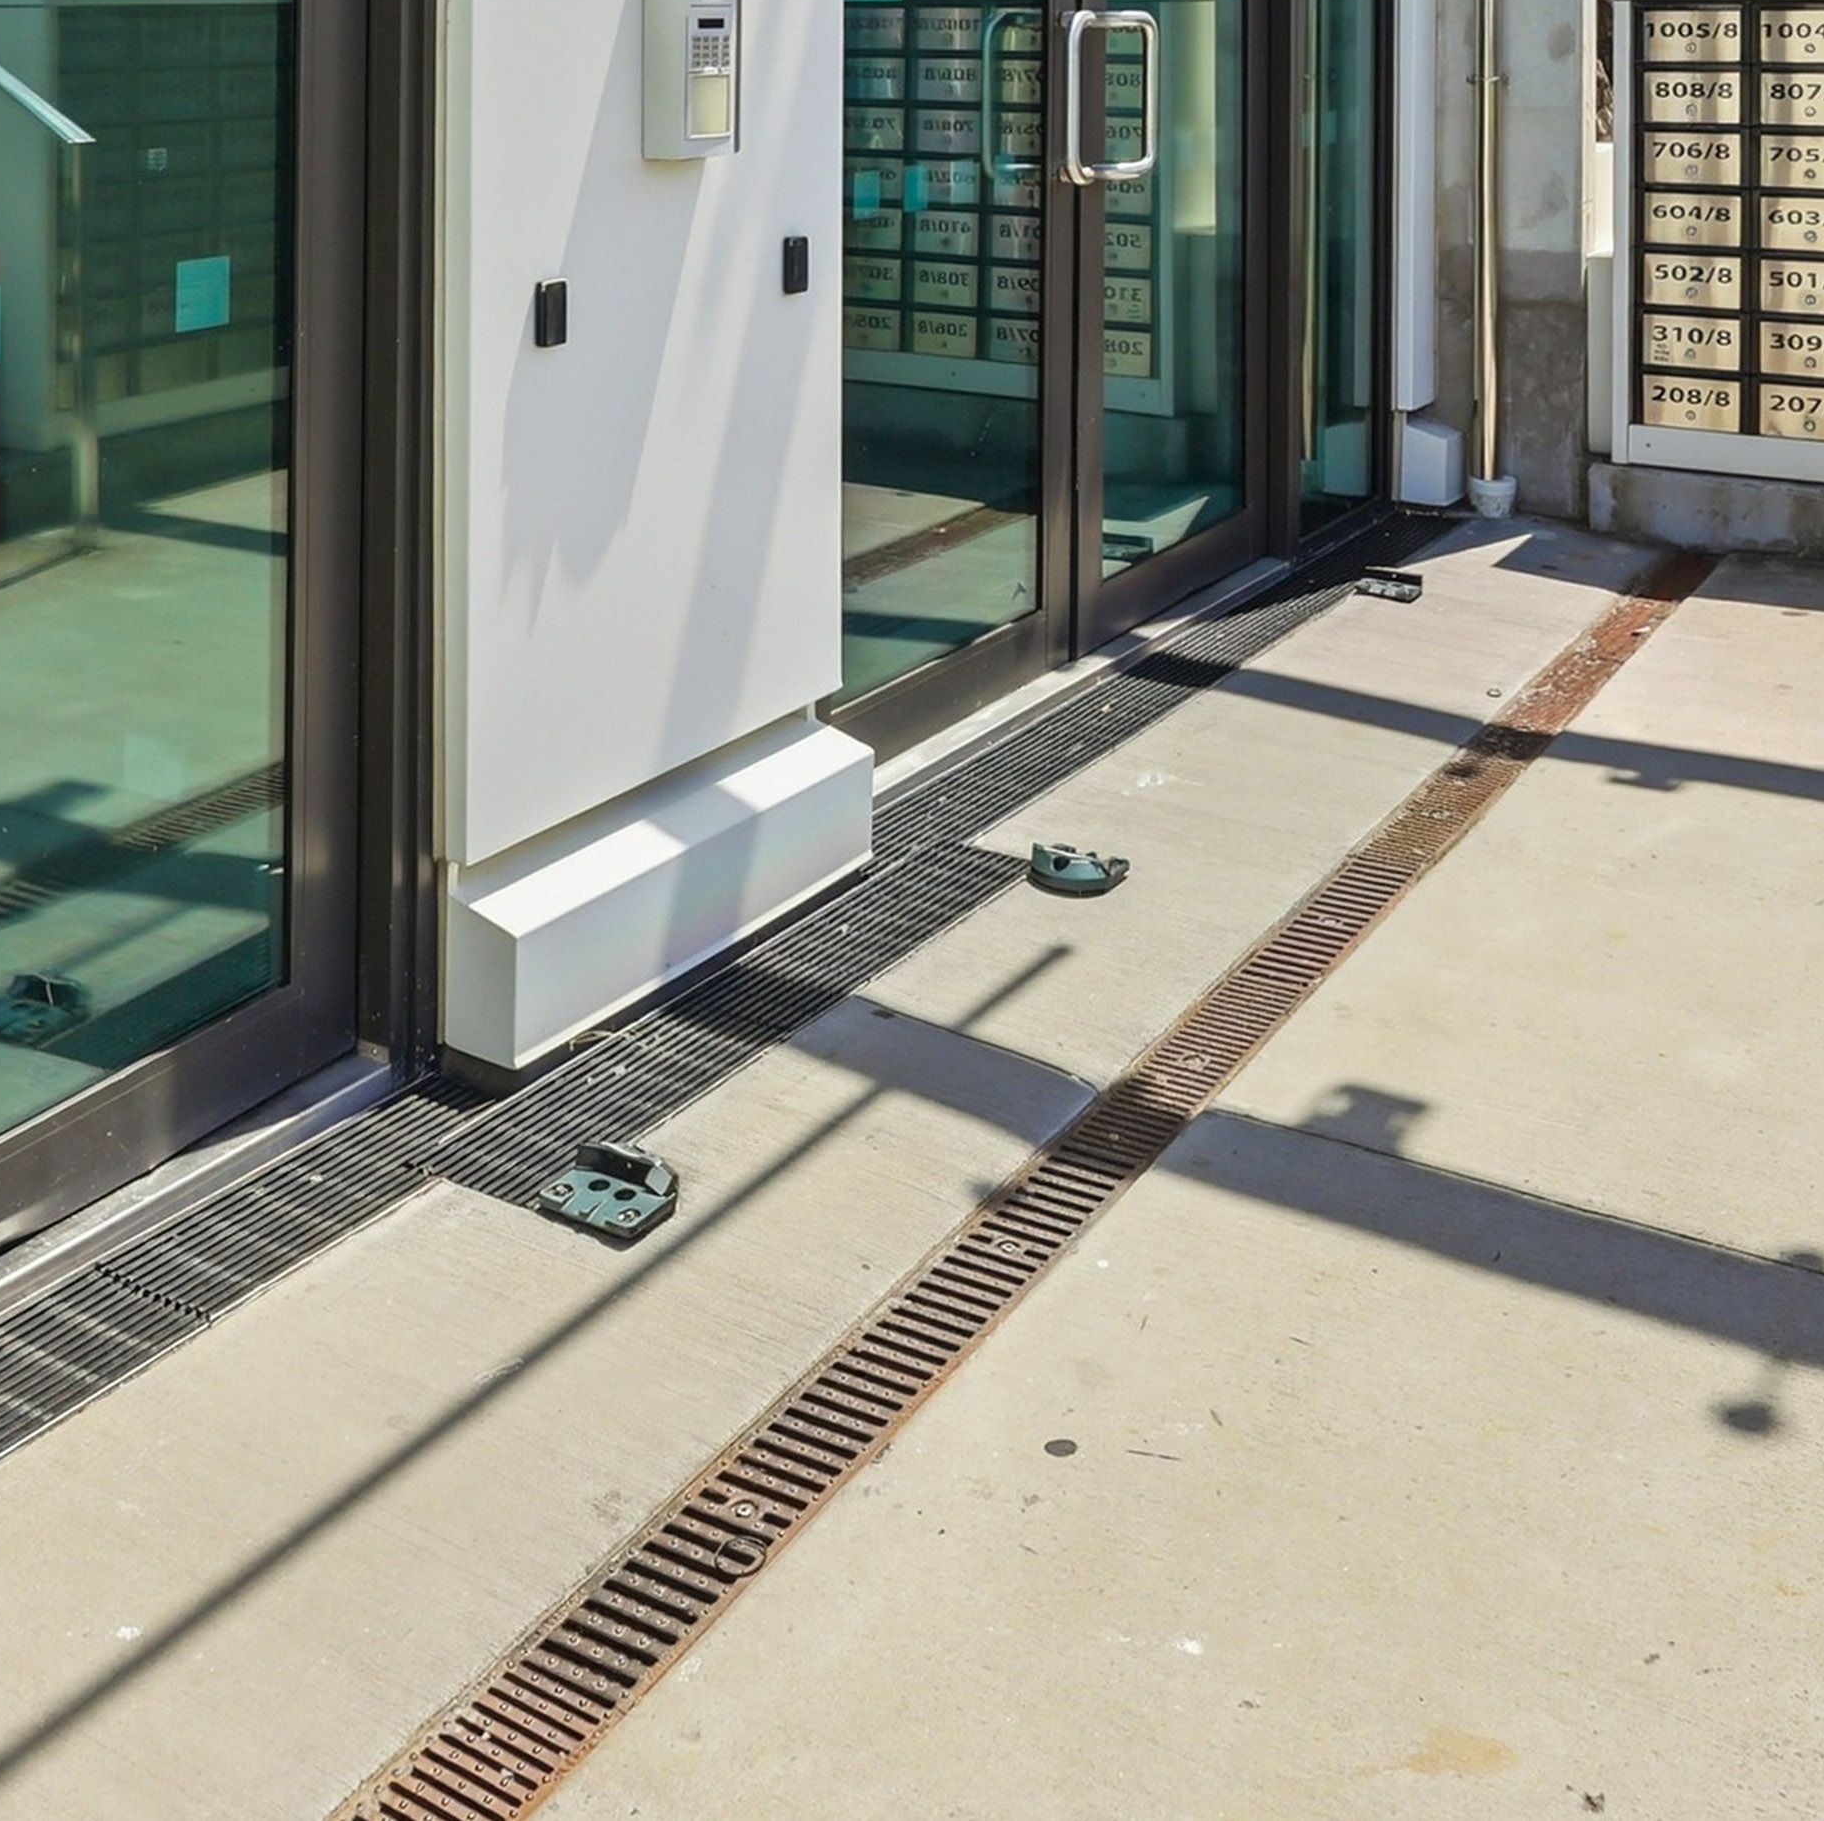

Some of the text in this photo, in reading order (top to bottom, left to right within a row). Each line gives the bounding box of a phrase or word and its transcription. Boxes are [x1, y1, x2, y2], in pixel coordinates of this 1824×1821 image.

[1644, 22, 1738, 39] 1005/8
[1654, 81, 1733, 100] 808/8
[1652, 142, 1729, 160] 706/8
[1652, 205, 1731, 222] 604/8
[1653, 265, 1732, 284] 502/8
[1653, 325, 1732, 346] 310/8
[1651, 385, 1730, 407] 208/8
